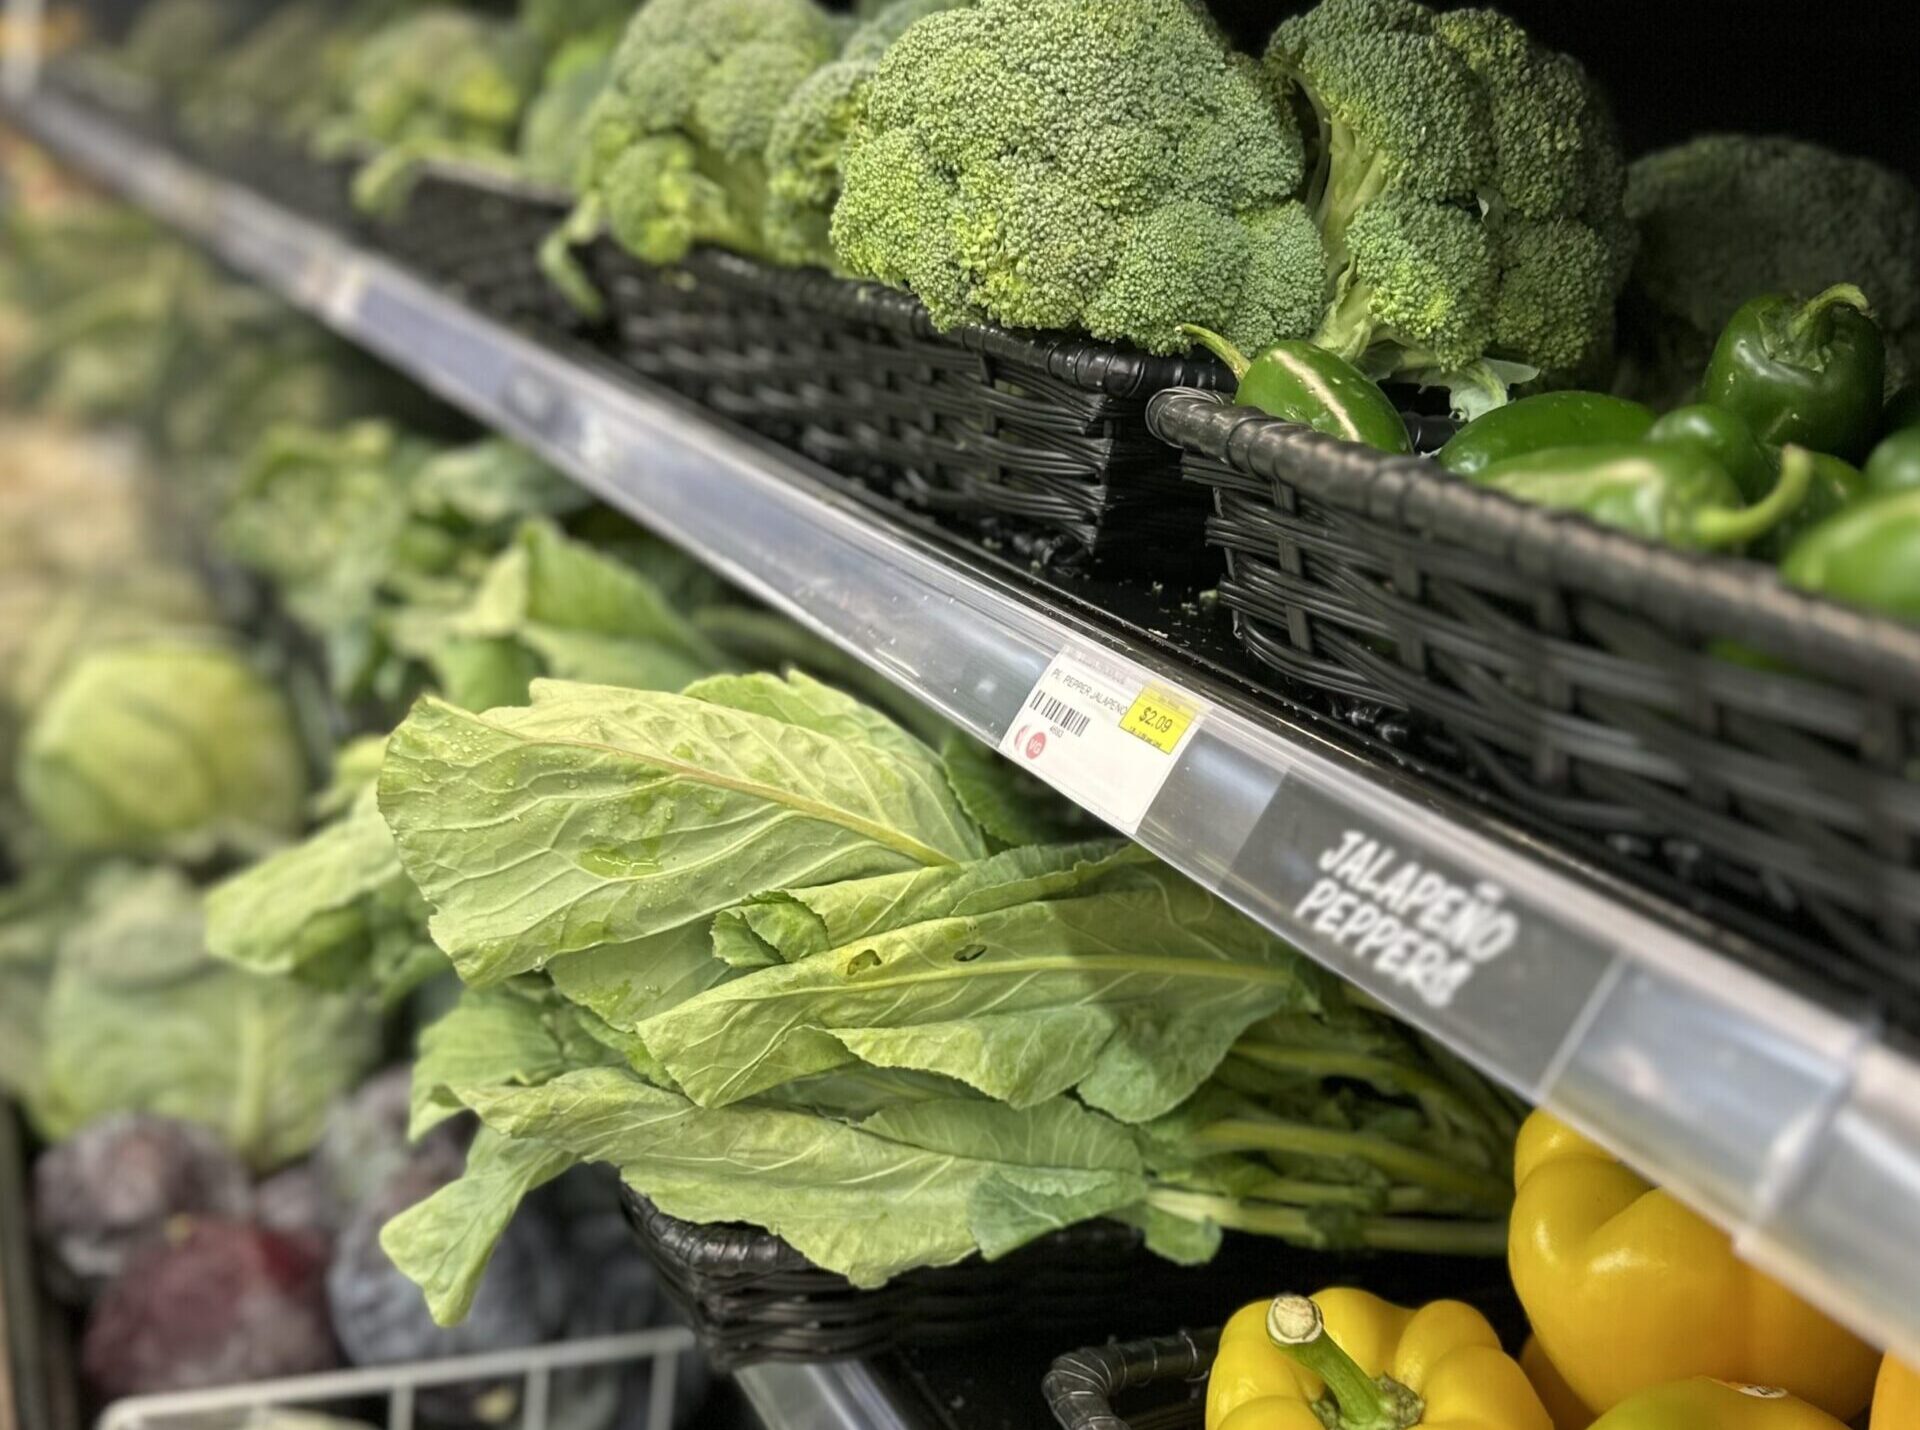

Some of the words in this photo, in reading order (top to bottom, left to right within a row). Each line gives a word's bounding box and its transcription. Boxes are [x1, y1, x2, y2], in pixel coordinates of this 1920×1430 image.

[1062, 674, 1092, 697] PEPPER
[1138, 706, 1173, 733] $2.09
[1317, 829, 1520, 962] JALAPEÑO
[1294, 879, 1474, 1008] PEPPERS
